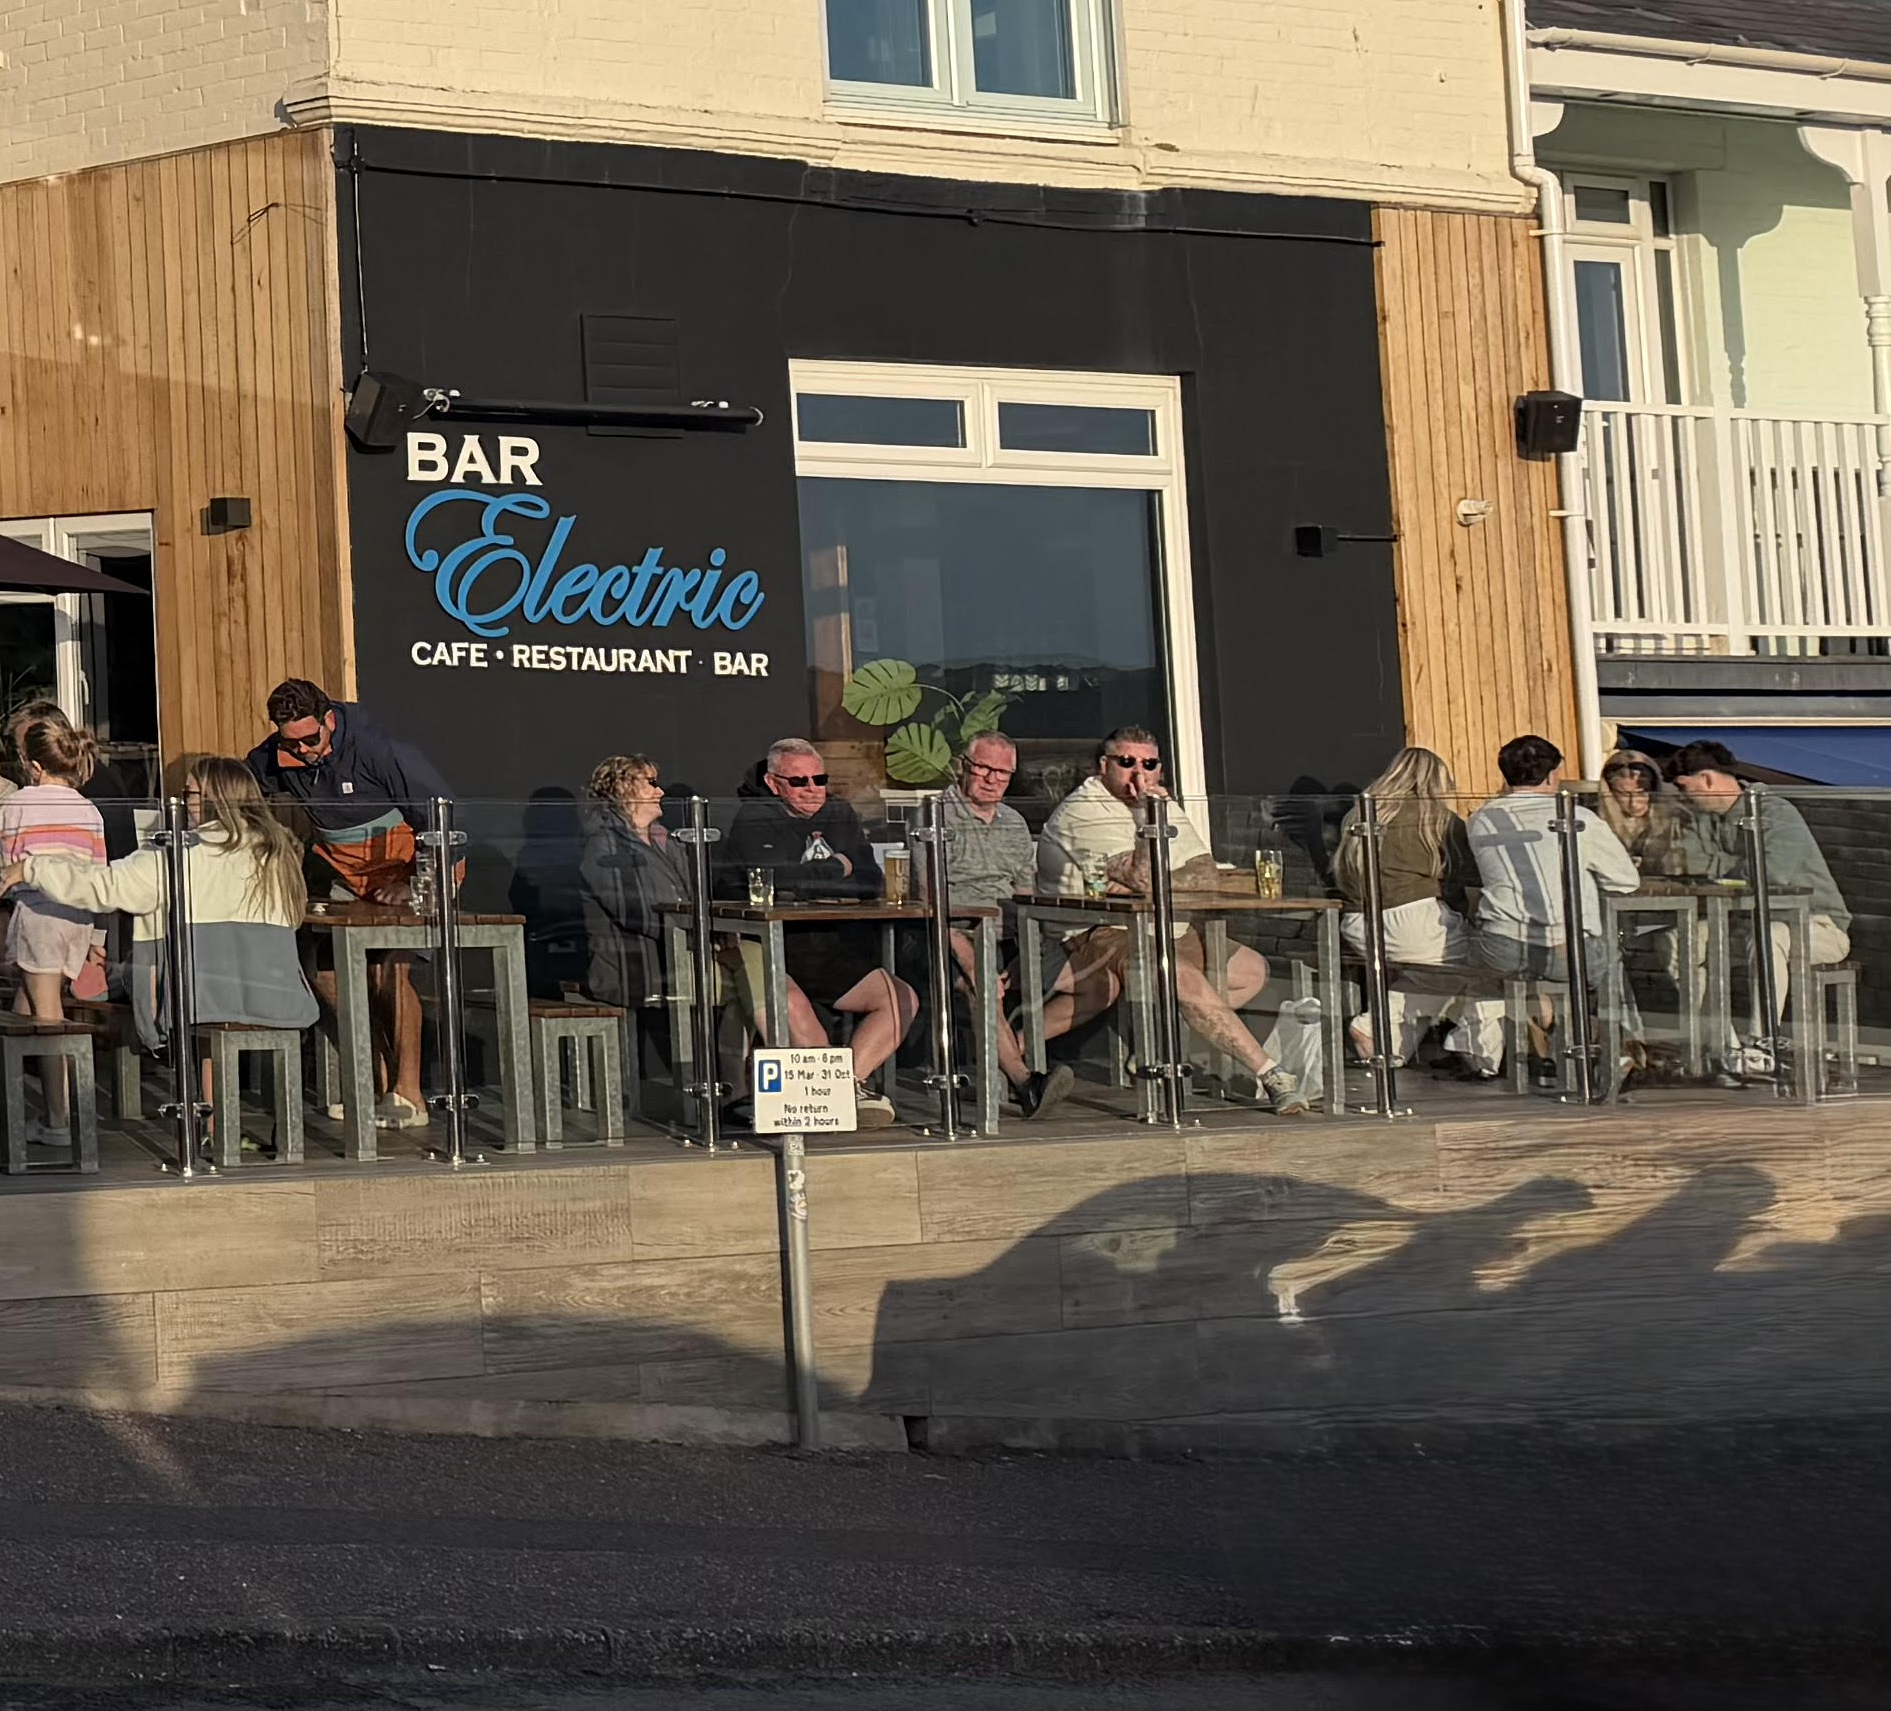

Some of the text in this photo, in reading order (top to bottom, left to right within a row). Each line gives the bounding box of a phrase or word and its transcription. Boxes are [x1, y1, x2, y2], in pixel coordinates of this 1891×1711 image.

[406, 432, 544, 486] BAR
[405, 488, 765, 639] Electric
[411, 641, 769, 678] CAFE RESTAURANT BAR
[829, 1055, 843, 1065] pm
[797, 1069, 815, 1080] Mar
[821, 1069, 831, 1079] 31
[811, 1086, 831, 1096] hour
[784, 1104, 828, 1114] No return
[813, 1116, 839, 1126] hours
